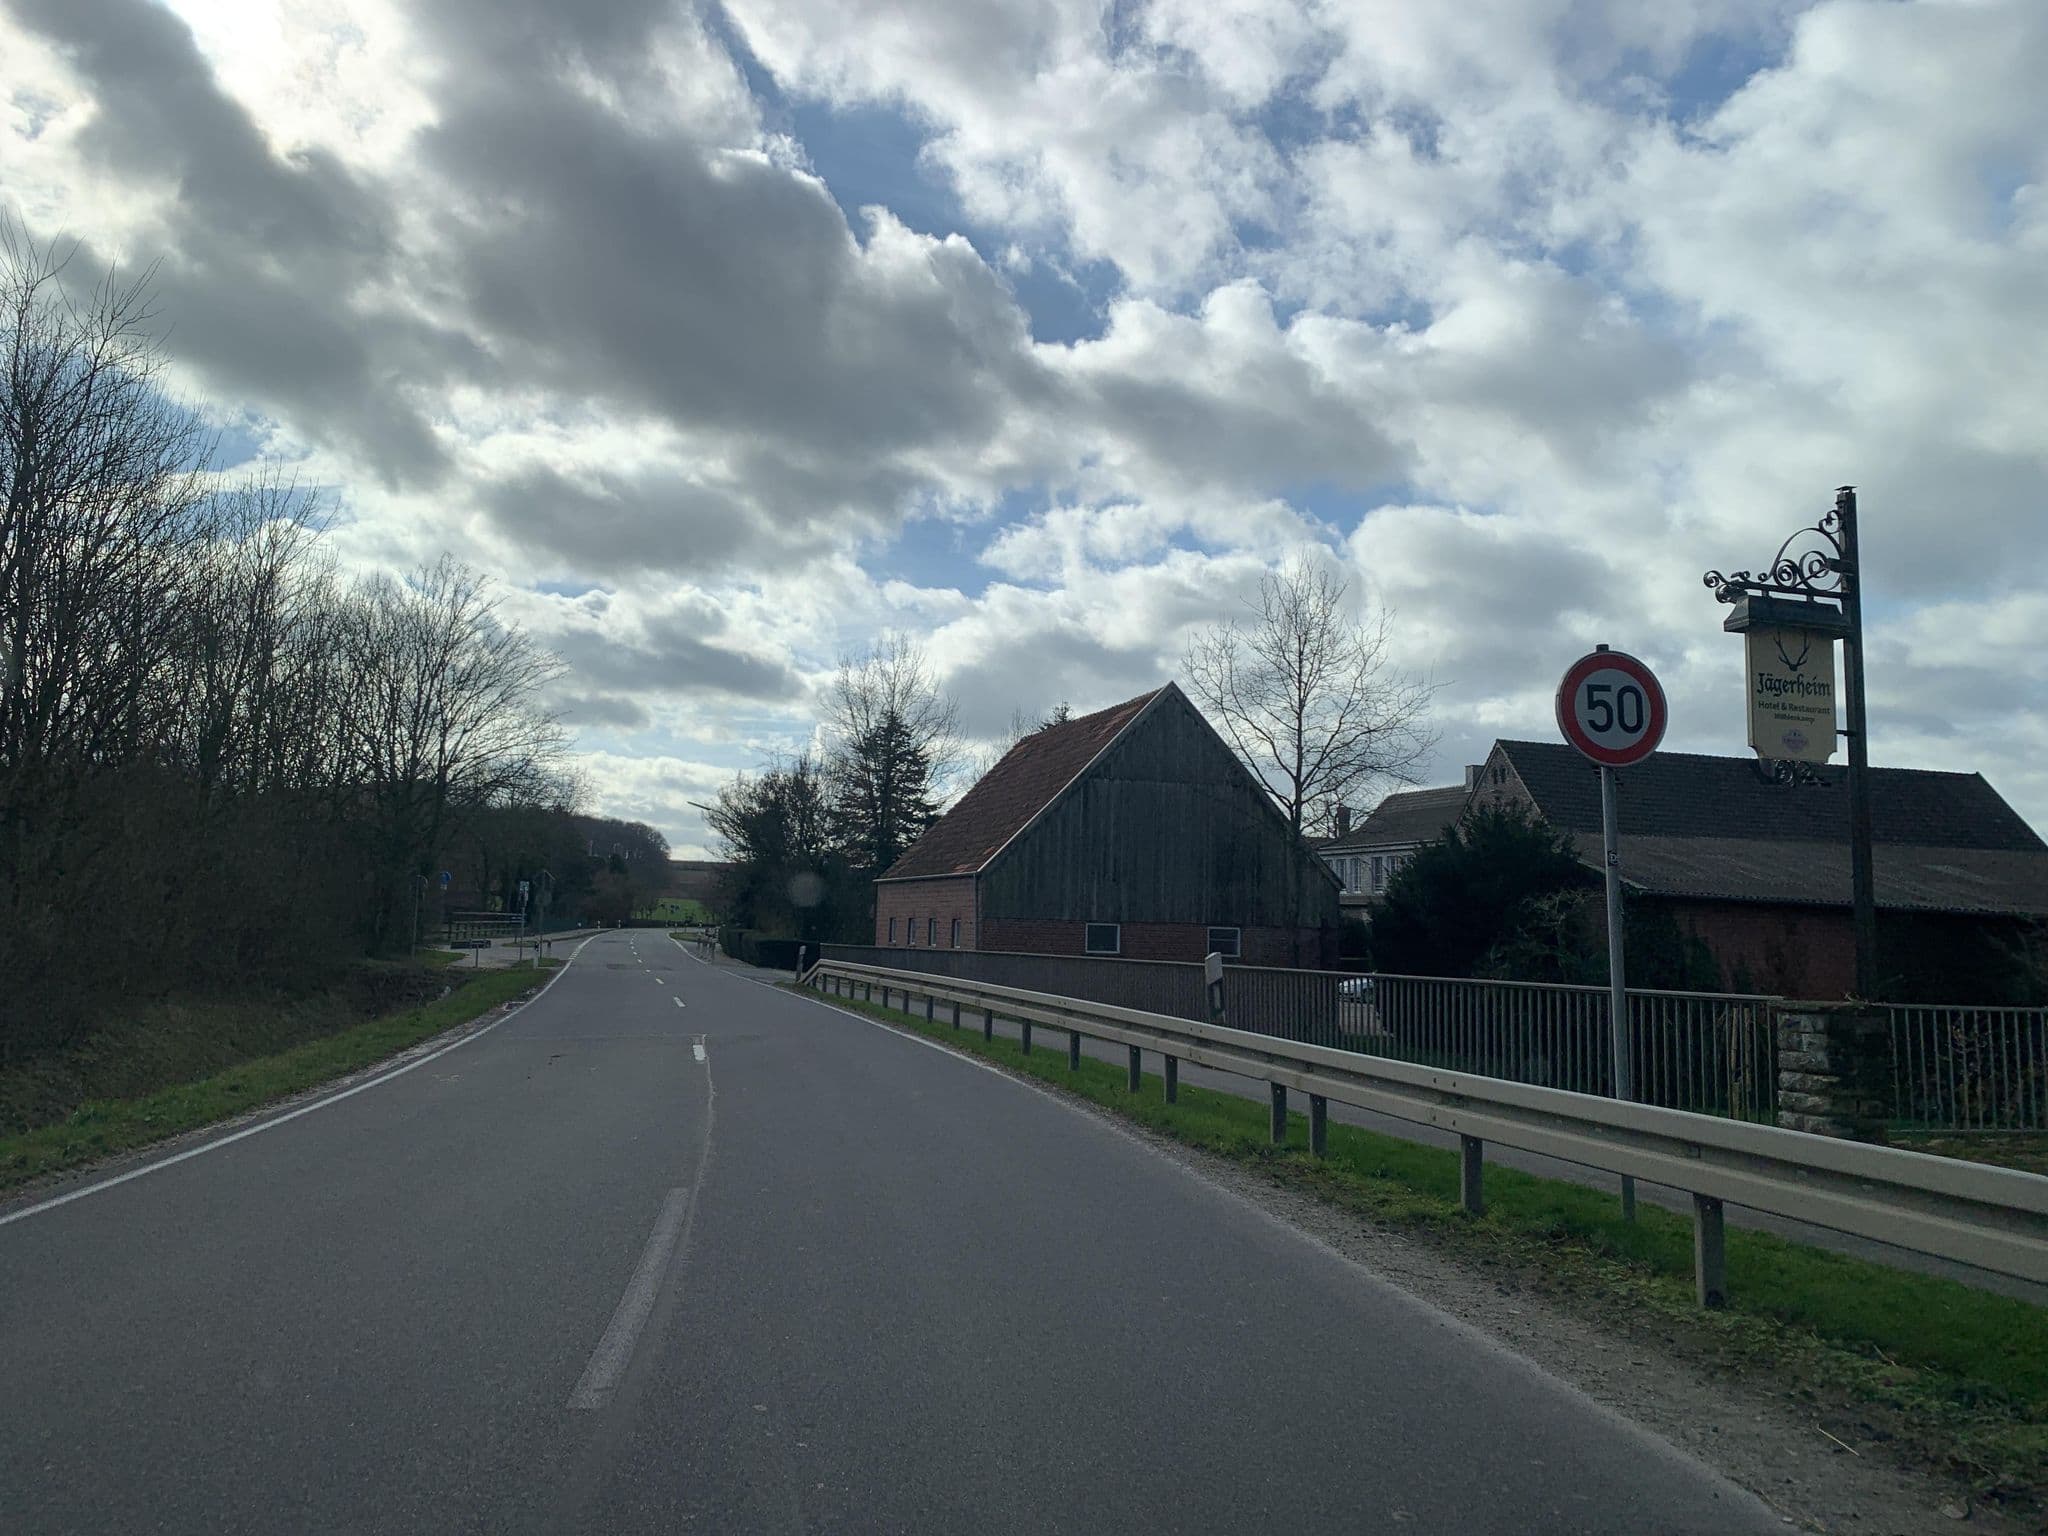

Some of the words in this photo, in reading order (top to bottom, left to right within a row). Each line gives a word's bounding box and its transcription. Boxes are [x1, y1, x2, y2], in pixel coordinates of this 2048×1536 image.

[1757, 673, 1831, 697] Jägerheim
[1586, 684, 1644, 734] 50
[1758, 701, 1779, 710] Hotel
[1781, 703, 1787, 711] &
[1789, 703, 1830, 714] Restaurant
